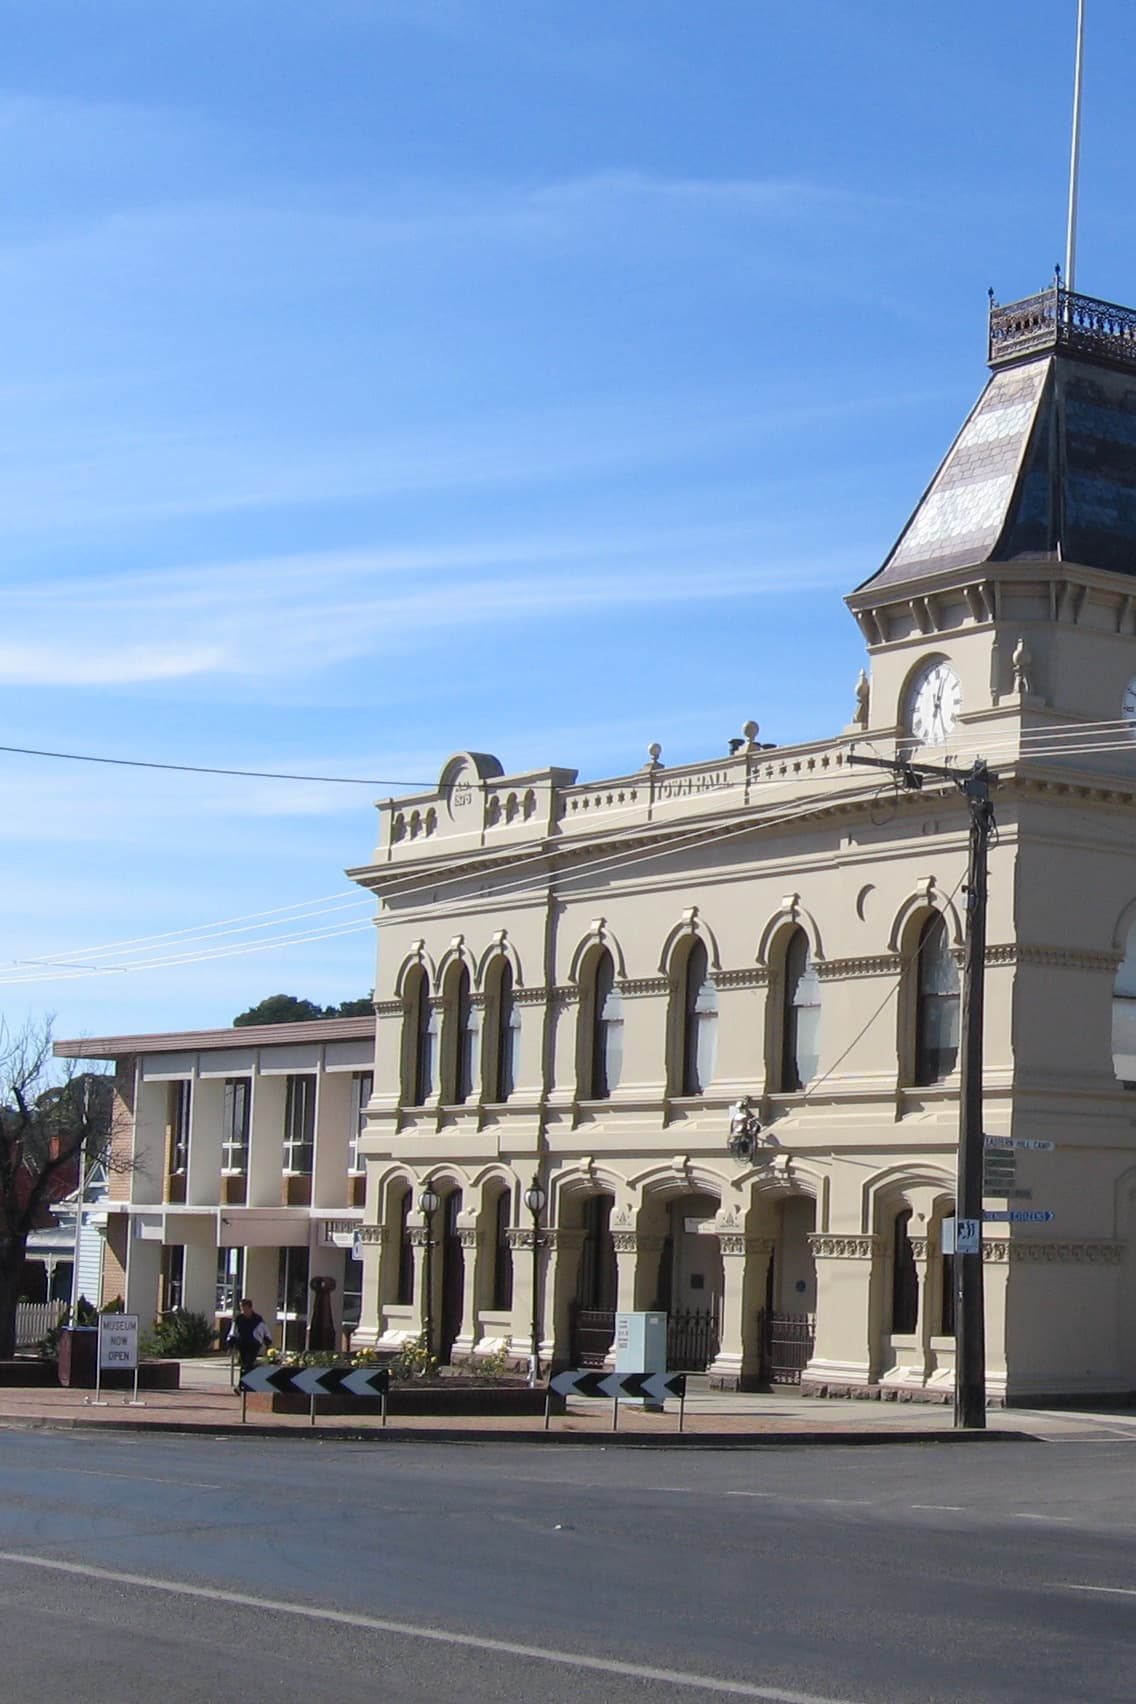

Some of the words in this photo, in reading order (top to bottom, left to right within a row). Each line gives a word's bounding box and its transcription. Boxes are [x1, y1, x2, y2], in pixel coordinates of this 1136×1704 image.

[696, 771, 734, 793] HALL
[103, 1320, 137, 1331] MUSEUM
[110, 1336, 128, 1346] NOW
[108, 1351, 129, 1361] OPEN
